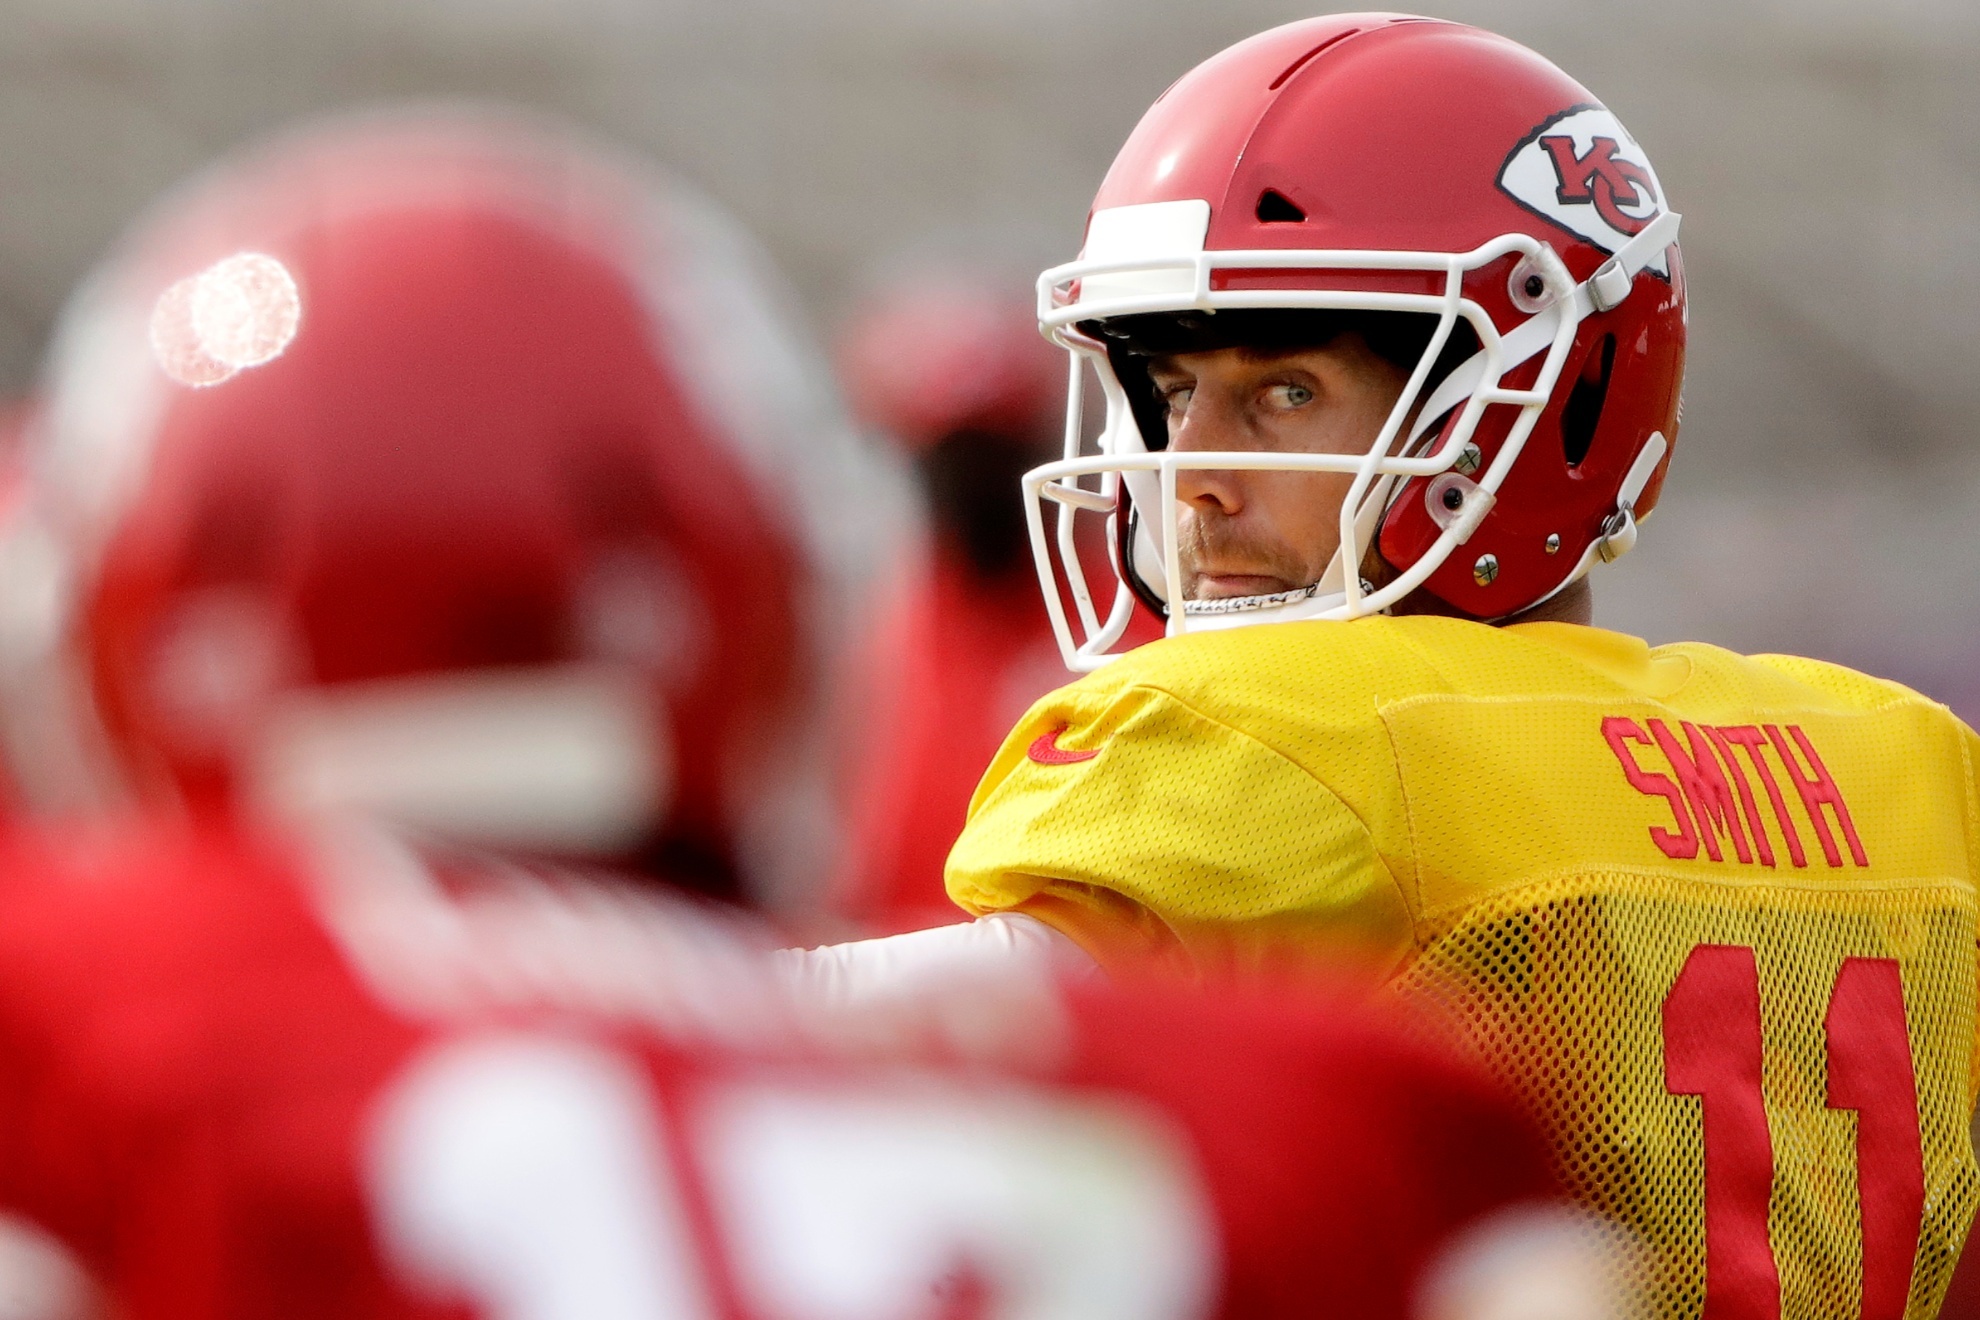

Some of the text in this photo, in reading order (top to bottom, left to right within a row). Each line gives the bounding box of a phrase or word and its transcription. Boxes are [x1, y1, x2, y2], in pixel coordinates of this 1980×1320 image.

[1539, 136, 1659, 237] KC
[1601, 715, 1869, 868] SMITH
[1662, 943, 1926, 1320] 11
